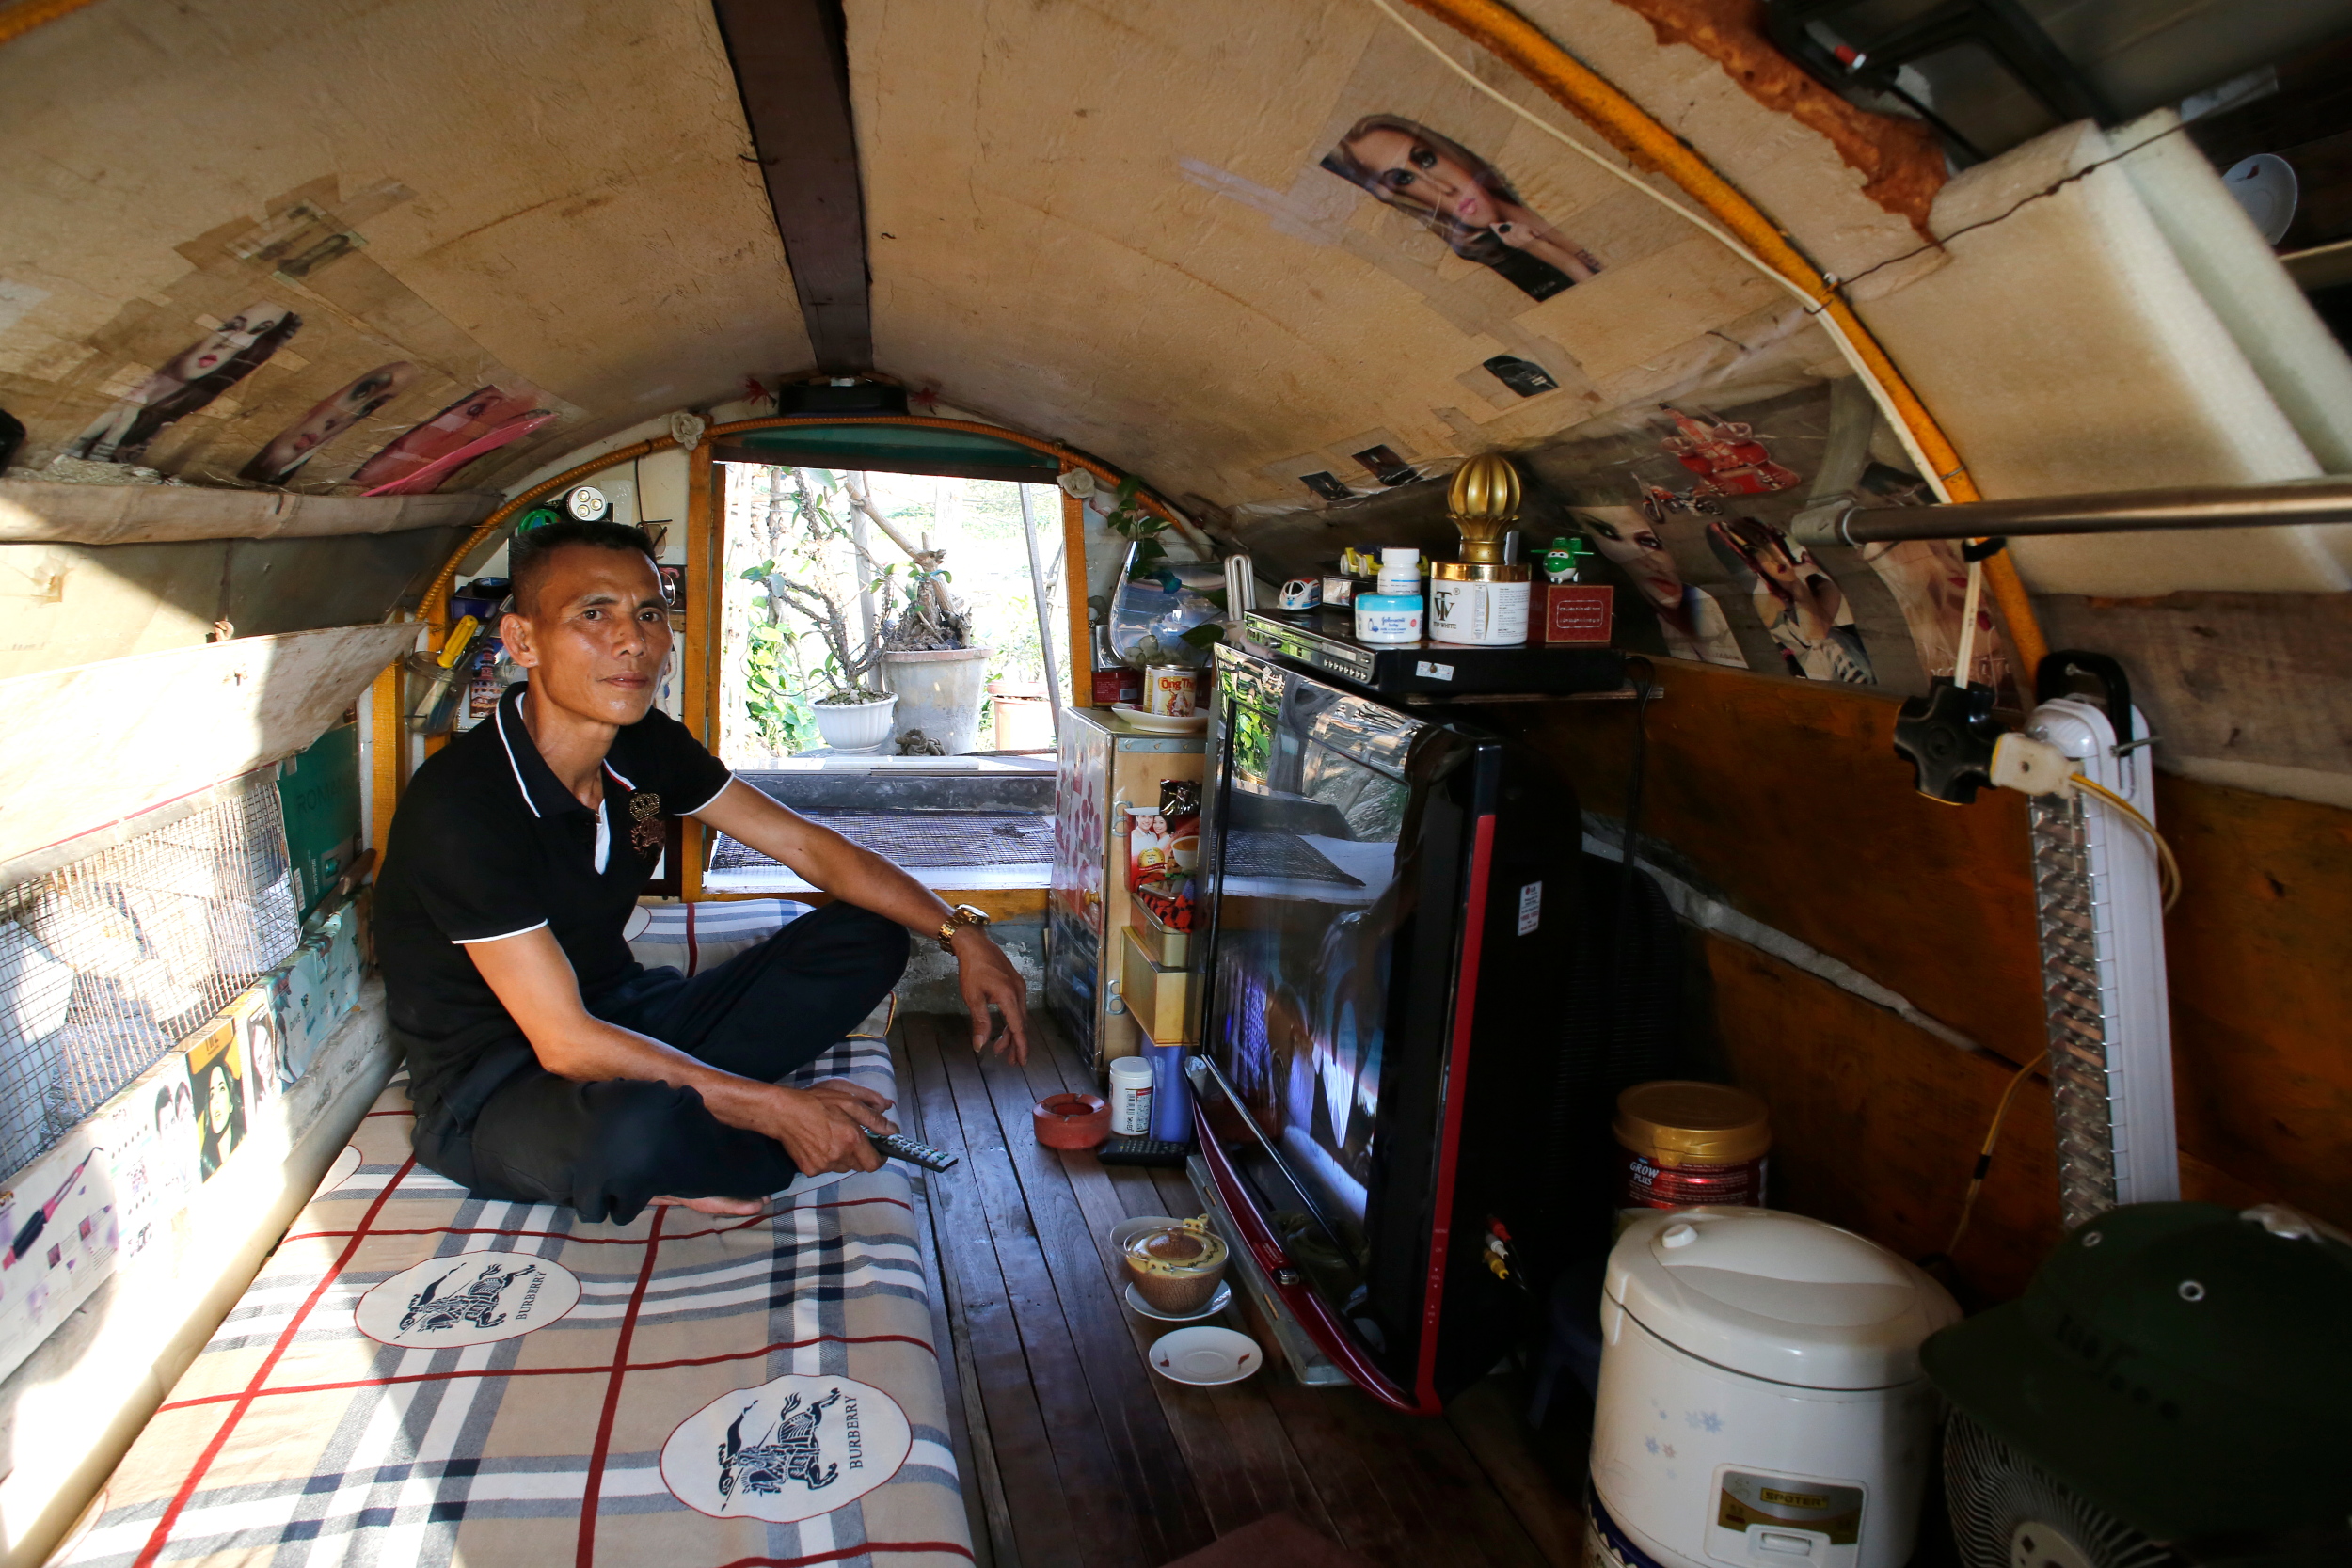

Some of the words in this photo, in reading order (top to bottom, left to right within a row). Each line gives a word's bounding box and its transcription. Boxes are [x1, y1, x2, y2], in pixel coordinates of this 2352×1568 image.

[1161, 677, 1182, 690] Ông
[289, 1011, 302, 1032] OLIVE
[1629, 1161, 1660, 1178] GROW
[1633, 1172, 1653, 1186] PLUS
[516, 1271, 547, 1320] BURBERRY
[844, 1395, 864, 1470] BURBERRY
